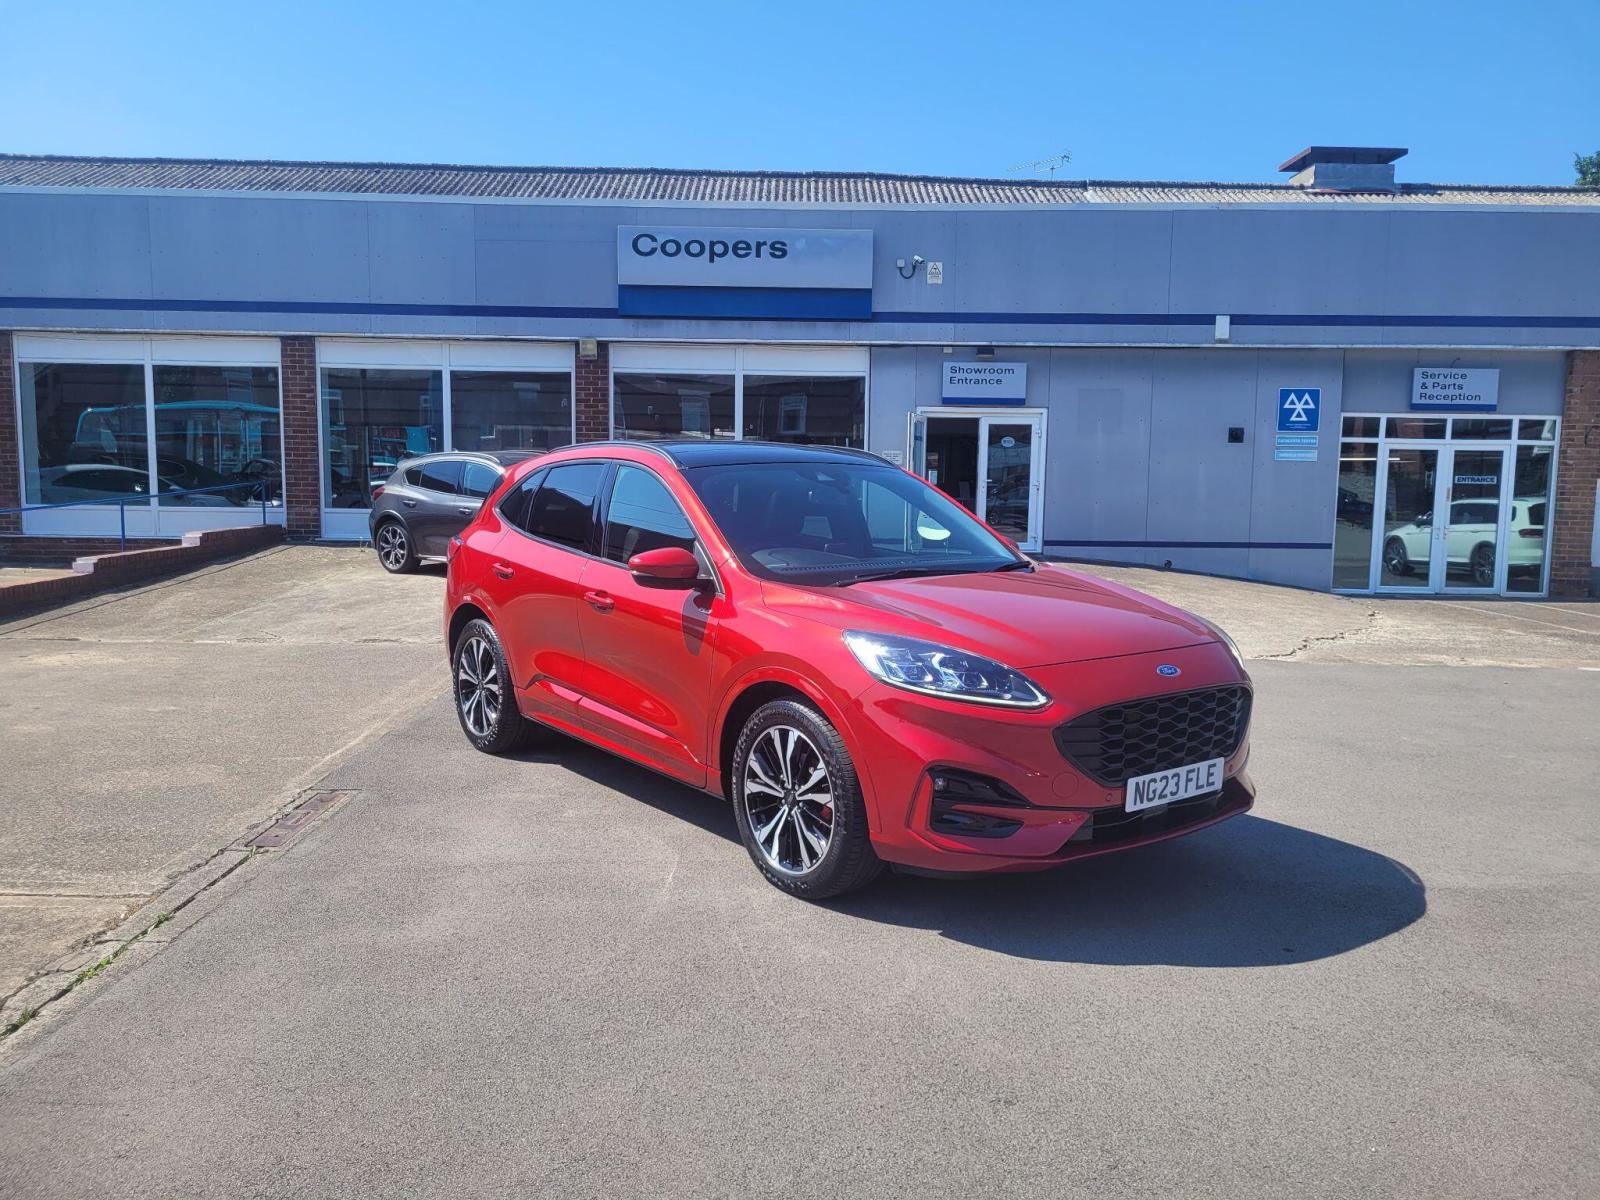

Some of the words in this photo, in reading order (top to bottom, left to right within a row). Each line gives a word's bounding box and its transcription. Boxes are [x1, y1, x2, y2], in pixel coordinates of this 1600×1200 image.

[632, 233, 788, 263] Coopers
[950, 365, 1015, 375] Showroom
[1421, 371, 1468, 380] Service
[949, 376, 1003, 385] Entrance
[1420, 381, 1428, 390] &
[1432, 381, 1464, 390] Parts
[1419, 392, 1481, 402] Reception
[1159, 666, 1178, 675] Ford
[1133, 772, 1181, 806] NG23
[1184, 763, 1217, 794] FLE
